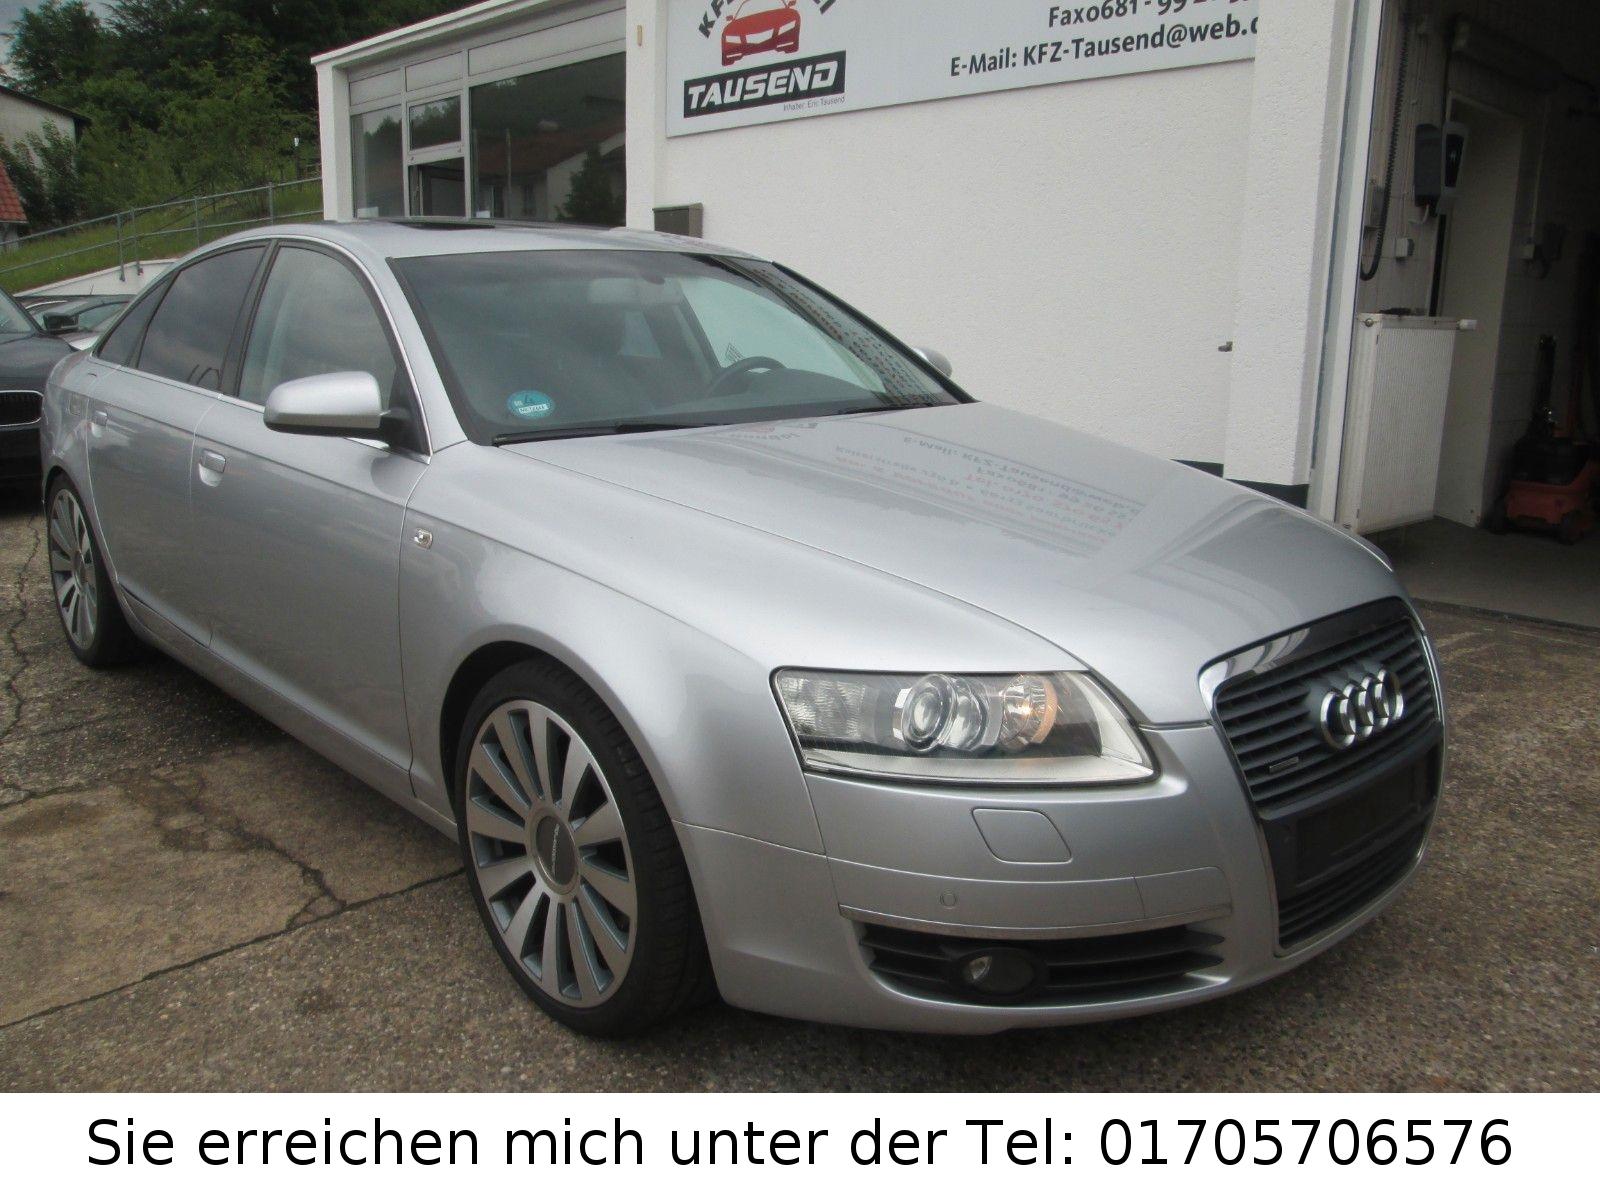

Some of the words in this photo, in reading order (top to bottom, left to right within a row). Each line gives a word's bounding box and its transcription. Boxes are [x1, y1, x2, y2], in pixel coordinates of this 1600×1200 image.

[951, 47, 1017, 76] E-Mail:
[688, 60, 838, 110] TAUSEND
[820, 96, 845, 106] Tausend
